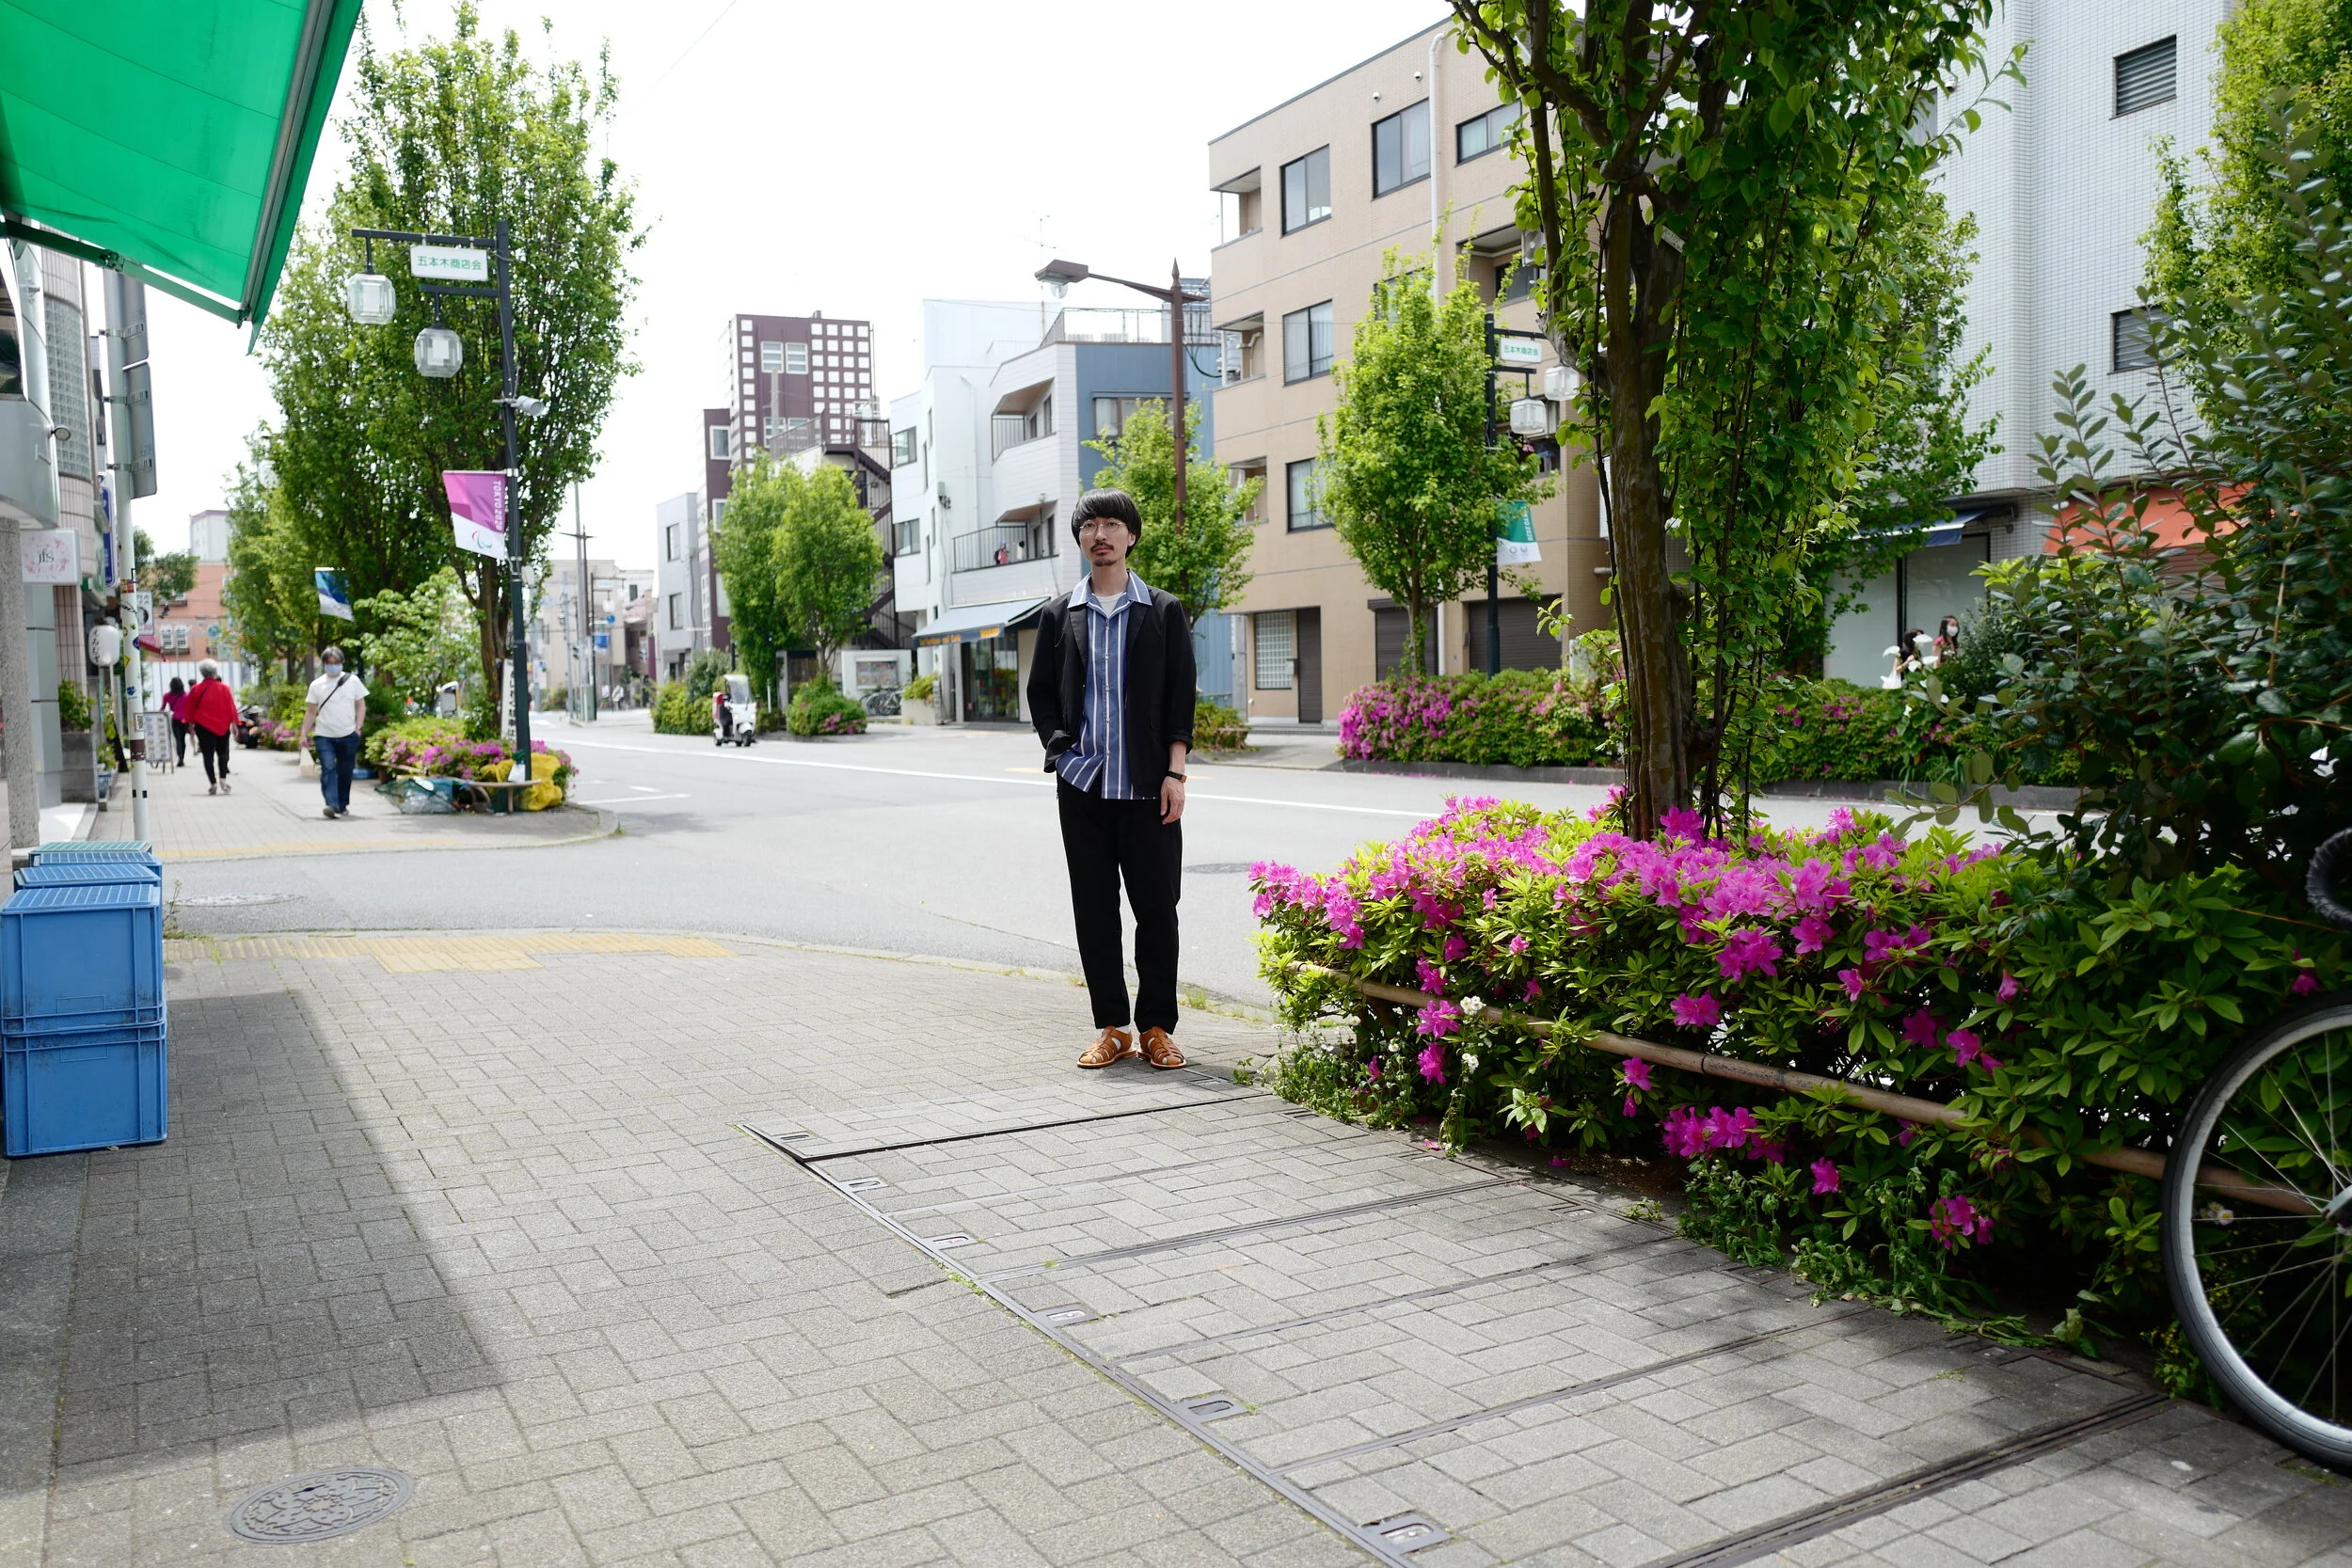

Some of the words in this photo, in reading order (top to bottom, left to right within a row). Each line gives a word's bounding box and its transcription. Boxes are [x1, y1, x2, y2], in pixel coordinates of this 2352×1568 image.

[417, 255, 482, 270] 五本木商店会
[493, 480, 501, 509] TOKYO
[494, 509, 502, 531] 2020
